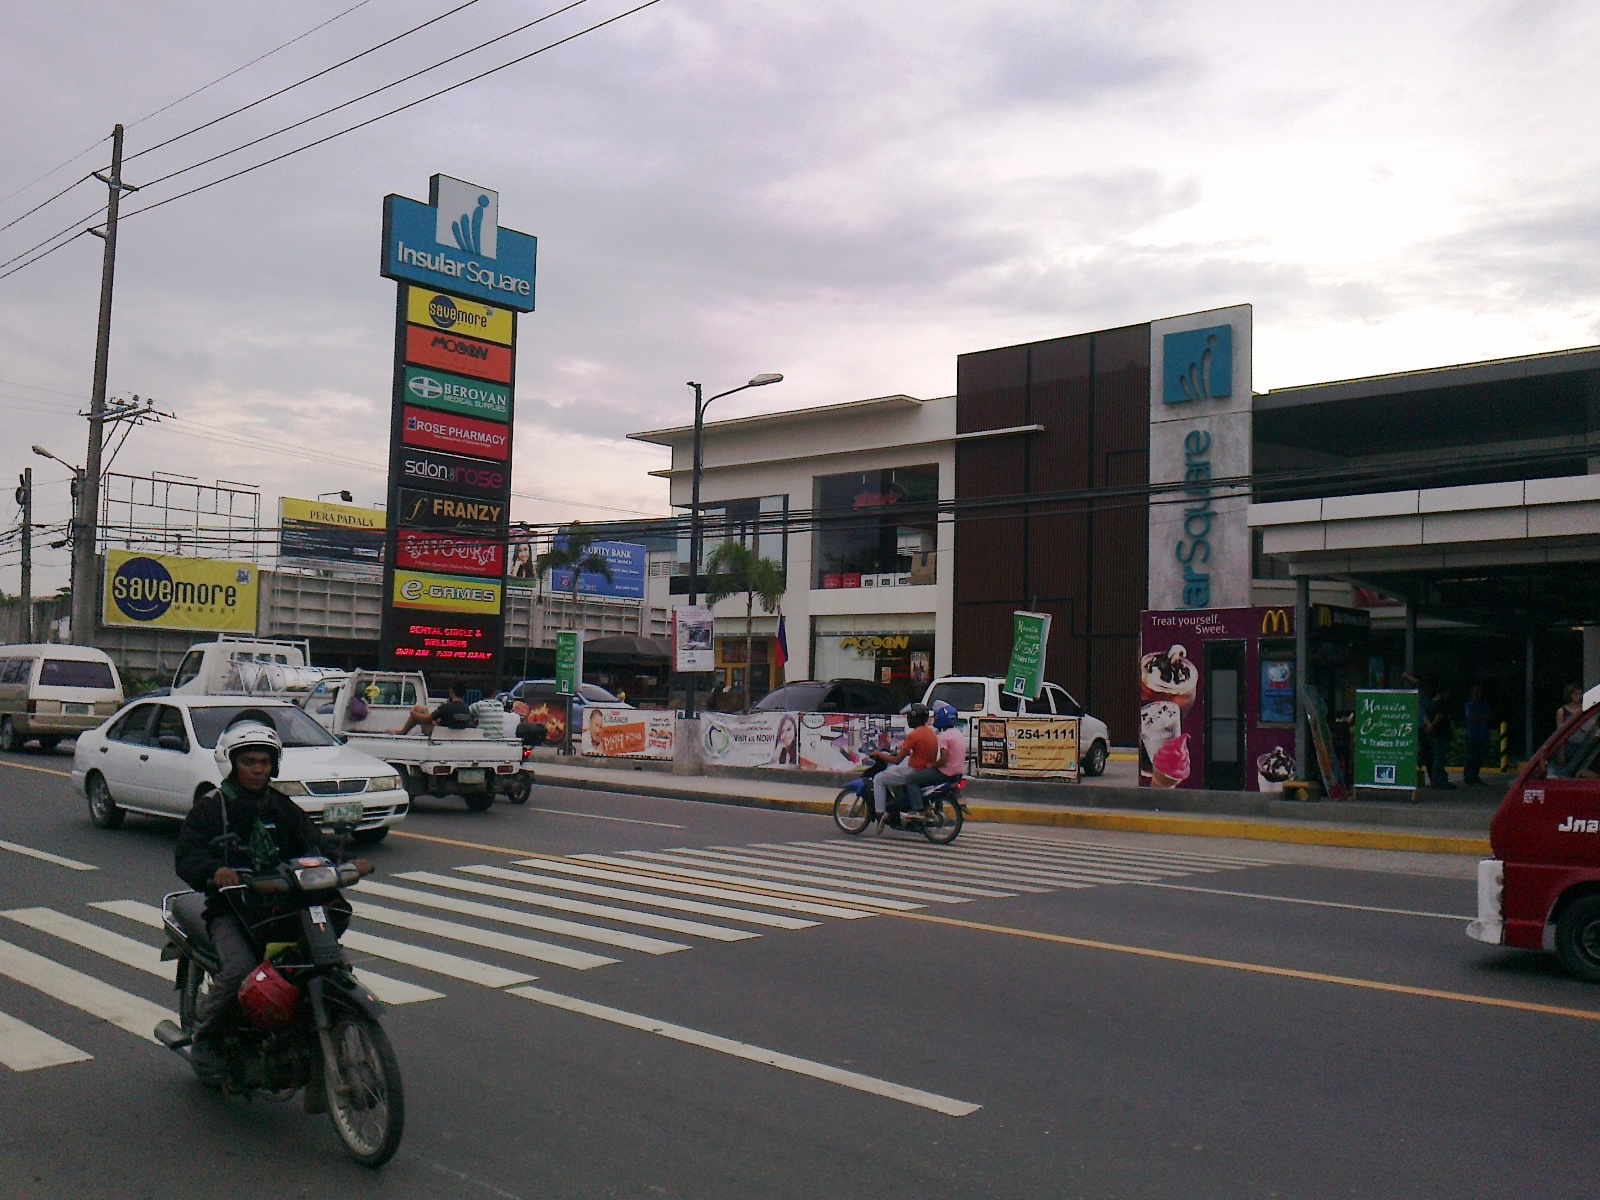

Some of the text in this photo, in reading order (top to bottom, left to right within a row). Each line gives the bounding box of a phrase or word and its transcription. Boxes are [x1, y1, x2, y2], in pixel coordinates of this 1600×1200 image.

[444, 383, 507, 406] BEROVAN
[443, 395, 507, 413] MEDICAL SUPPLIES
[416, 421, 447, 435] ROSE
[448, 426, 506, 445] PHARMACY
[404, 459, 448, 479] salon
[455, 466, 504, 490] rose
[309, 510, 336, 523] PERA
[337, 514, 375, 528] PADALA
[432, 498, 501, 522] FRANZY
[611, 548, 633, 559] BANK
[400, 579, 496, 603] e-GAMES
[174, 604, 237, 615] MARKET
[1151, 616, 1176, 627] Treat
[1361, 698, 1407, 715] Manila
[1017, 728, 1075, 740] 254-1111
[1558, 815, 1600, 834] Jna
